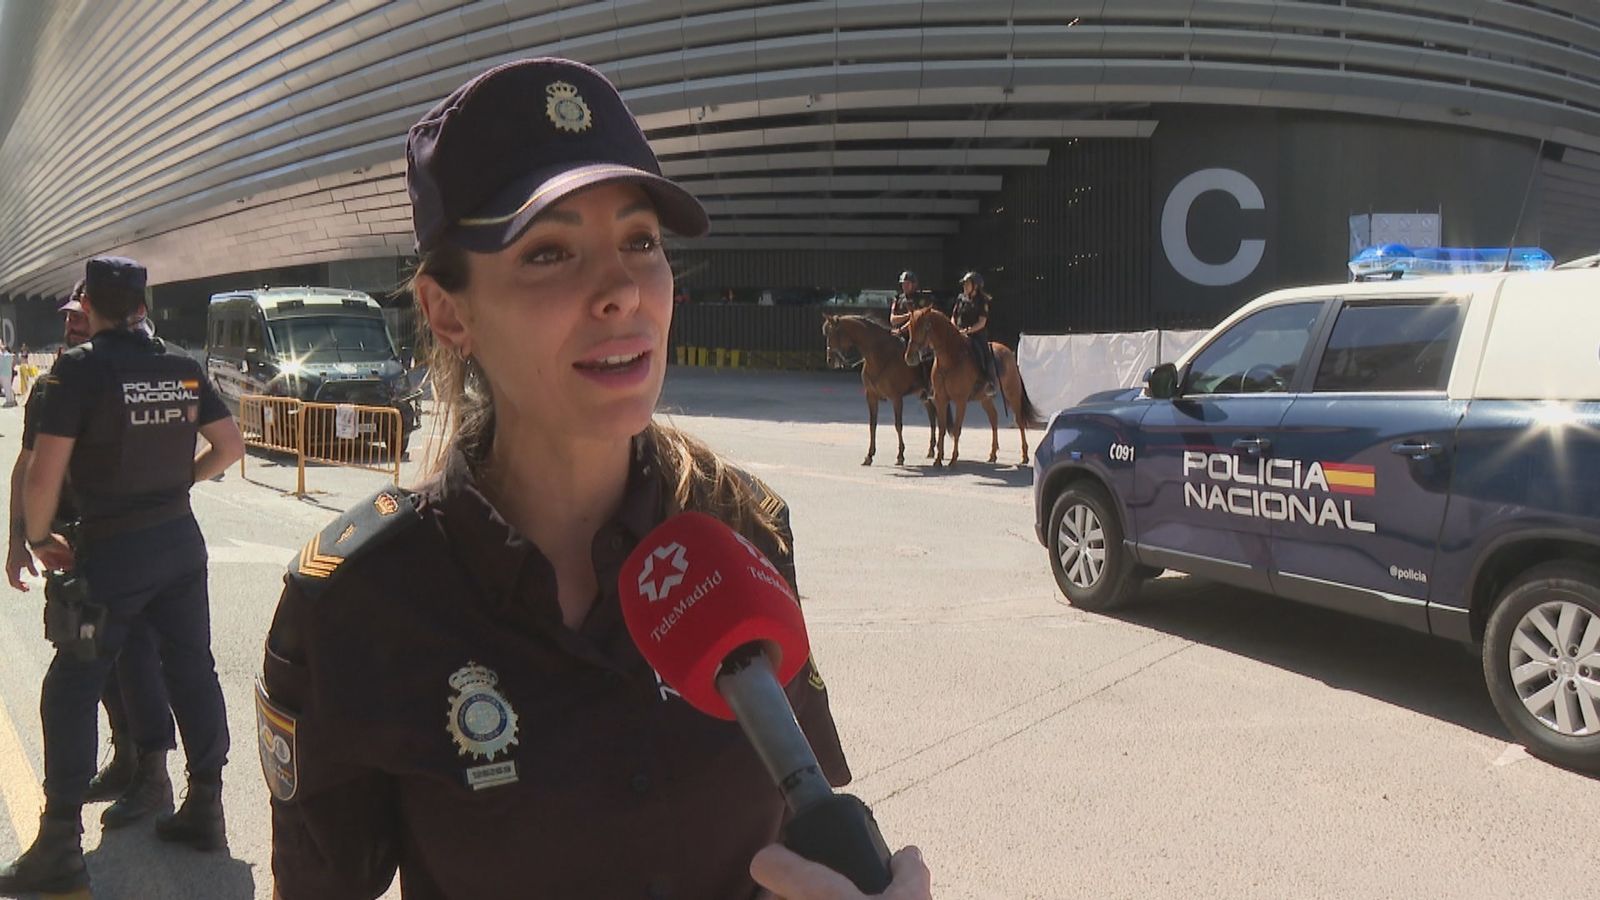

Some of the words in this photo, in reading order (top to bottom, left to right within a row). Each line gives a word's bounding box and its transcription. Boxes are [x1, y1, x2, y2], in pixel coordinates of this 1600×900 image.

[1161, 168, 1266, 286] C
[122, 381, 185, 392] POLICIA
[124, 390, 199, 404] NACIONAL
[131, 409, 186, 425] U.I.P.
[1183, 482, 1376, 533] NACIONAL
[1390, 565, 1427, 583] @policia
[650, 569, 723, 643] TeleMadrid
